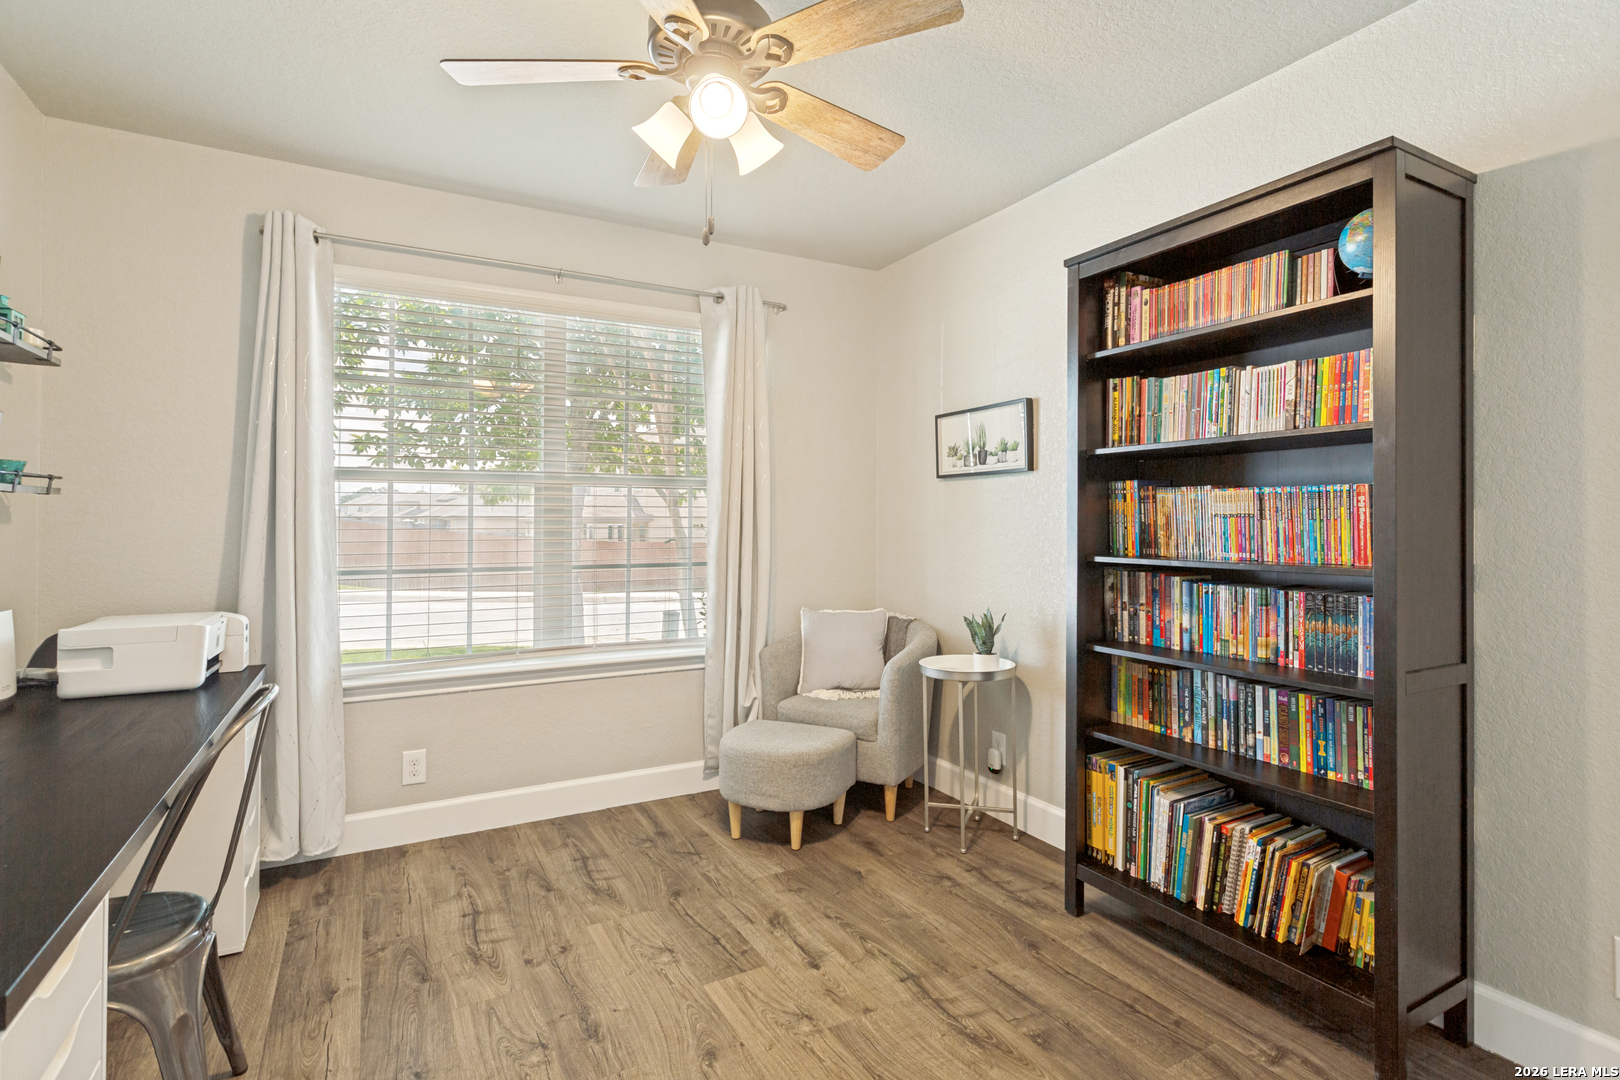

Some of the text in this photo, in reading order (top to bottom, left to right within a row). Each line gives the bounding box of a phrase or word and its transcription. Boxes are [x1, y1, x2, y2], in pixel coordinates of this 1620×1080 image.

[1278, 708, 1289, 744] CANDY SHOP
[1290, 720, 1299, 746] RESCUE
